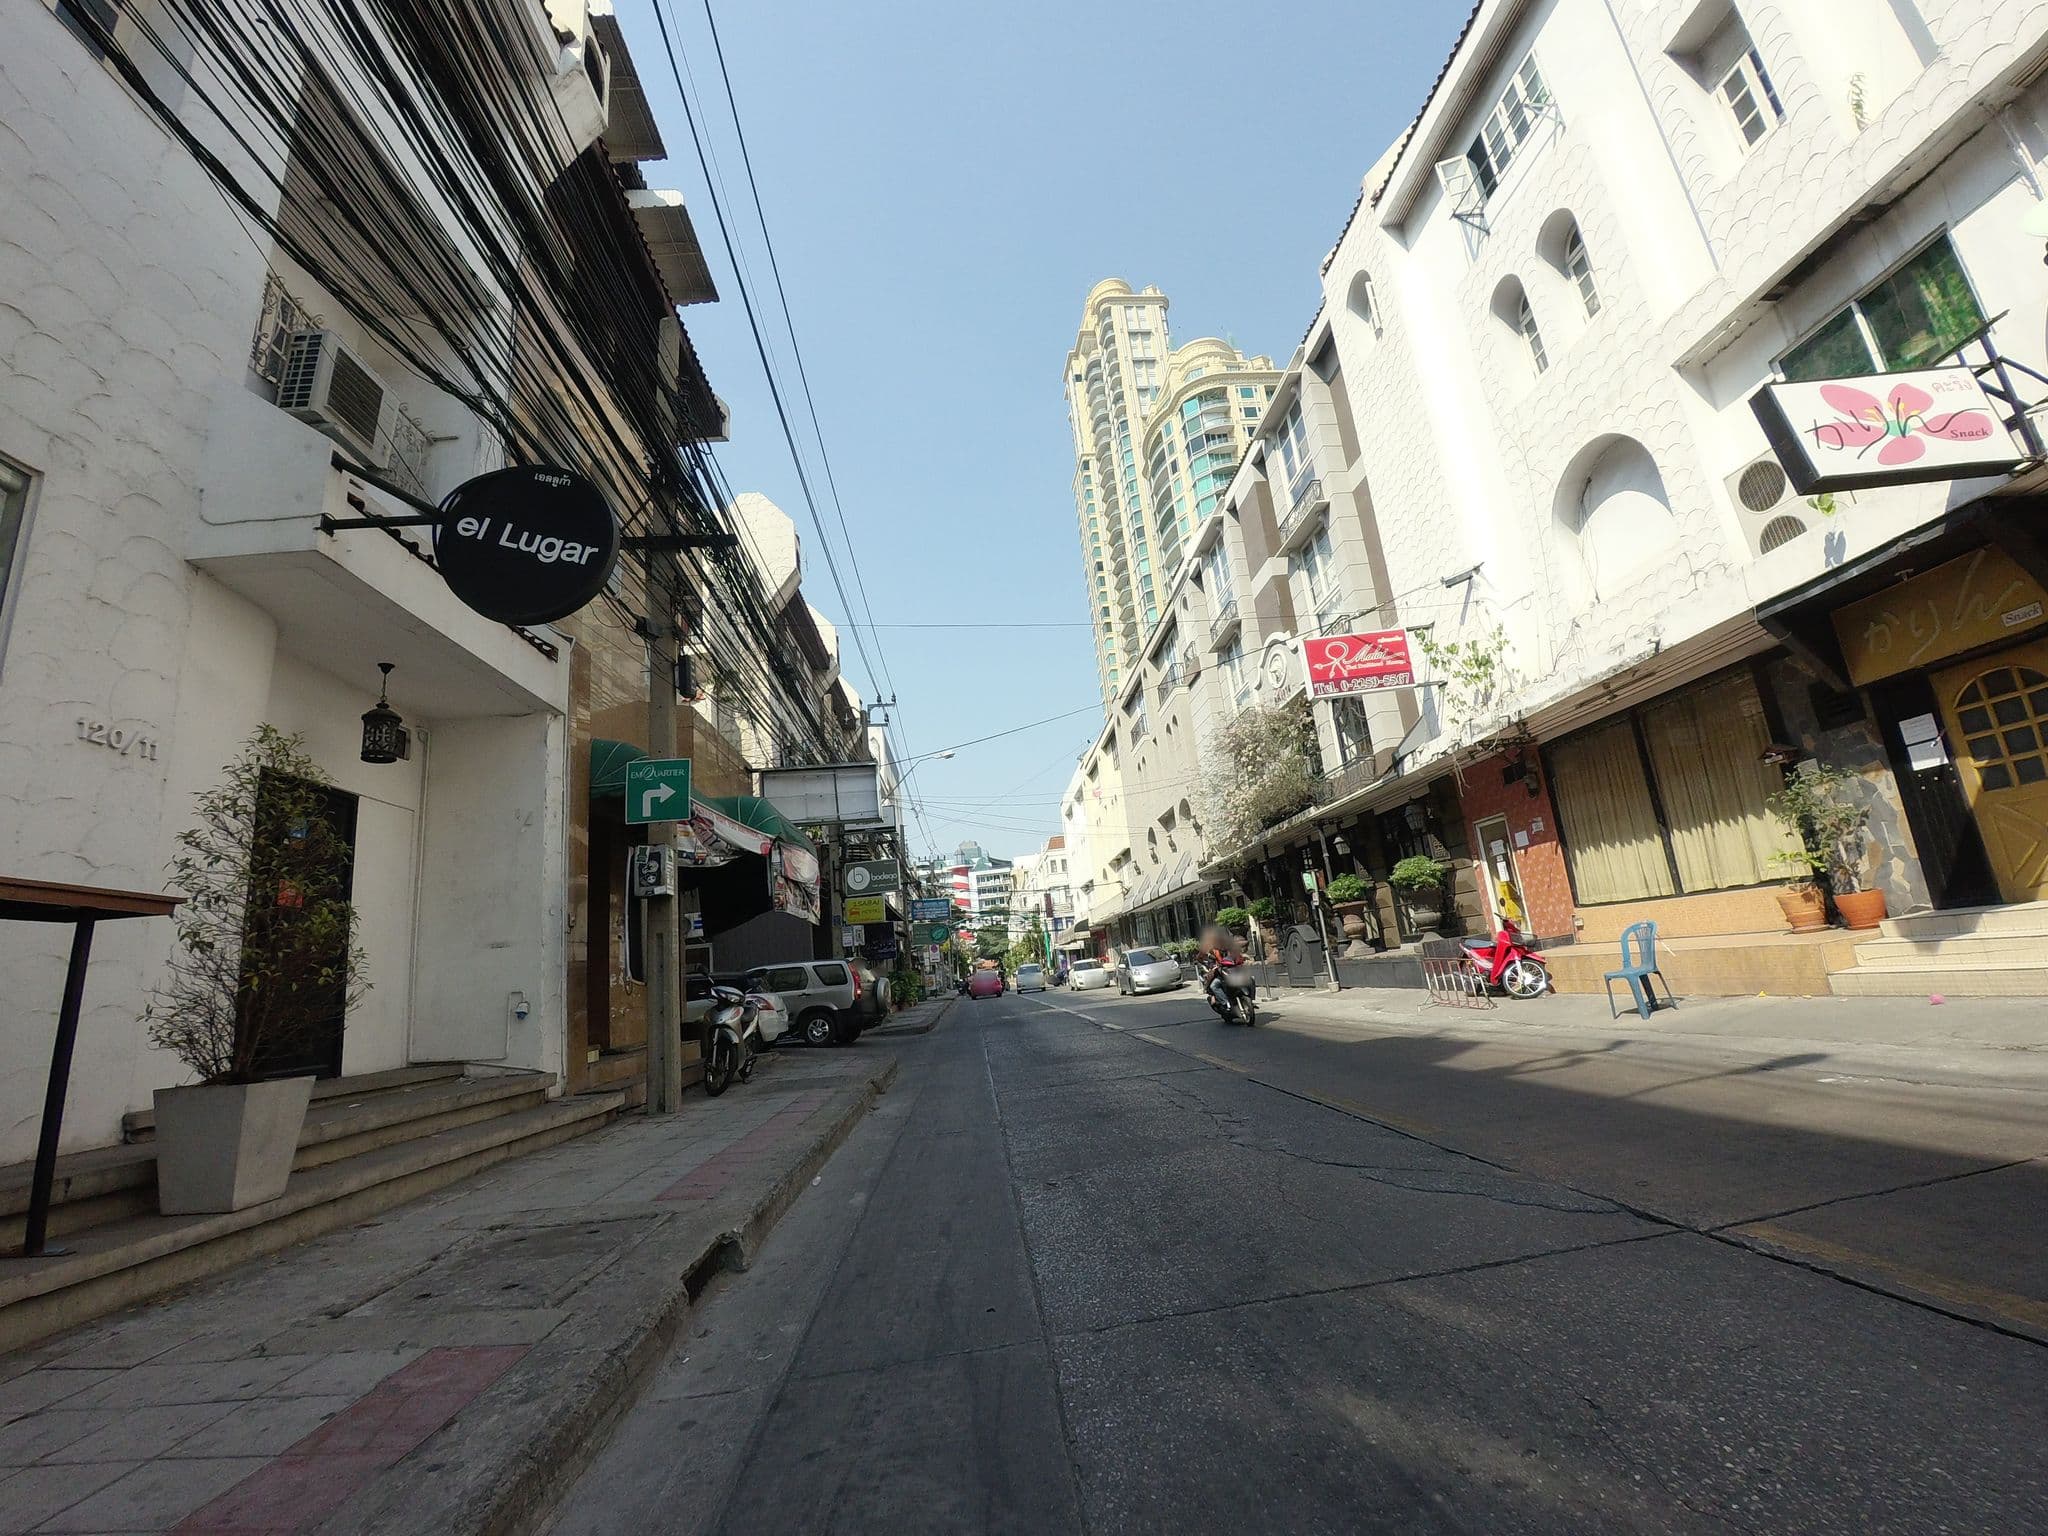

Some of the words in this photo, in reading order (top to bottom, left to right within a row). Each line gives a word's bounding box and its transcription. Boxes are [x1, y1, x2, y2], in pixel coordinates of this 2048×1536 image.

[1804, 397, 1990, 460] かりん
[1950, 428, 1990, 439] Snack
[456, 516, 492, 541] el
[498, 522, 600, 566] Lugar
[2005, 603, 2040, 625] Snack
[1314, 681, 1339, 695] Tel.
[76, 719, 158, 761] 120/11
